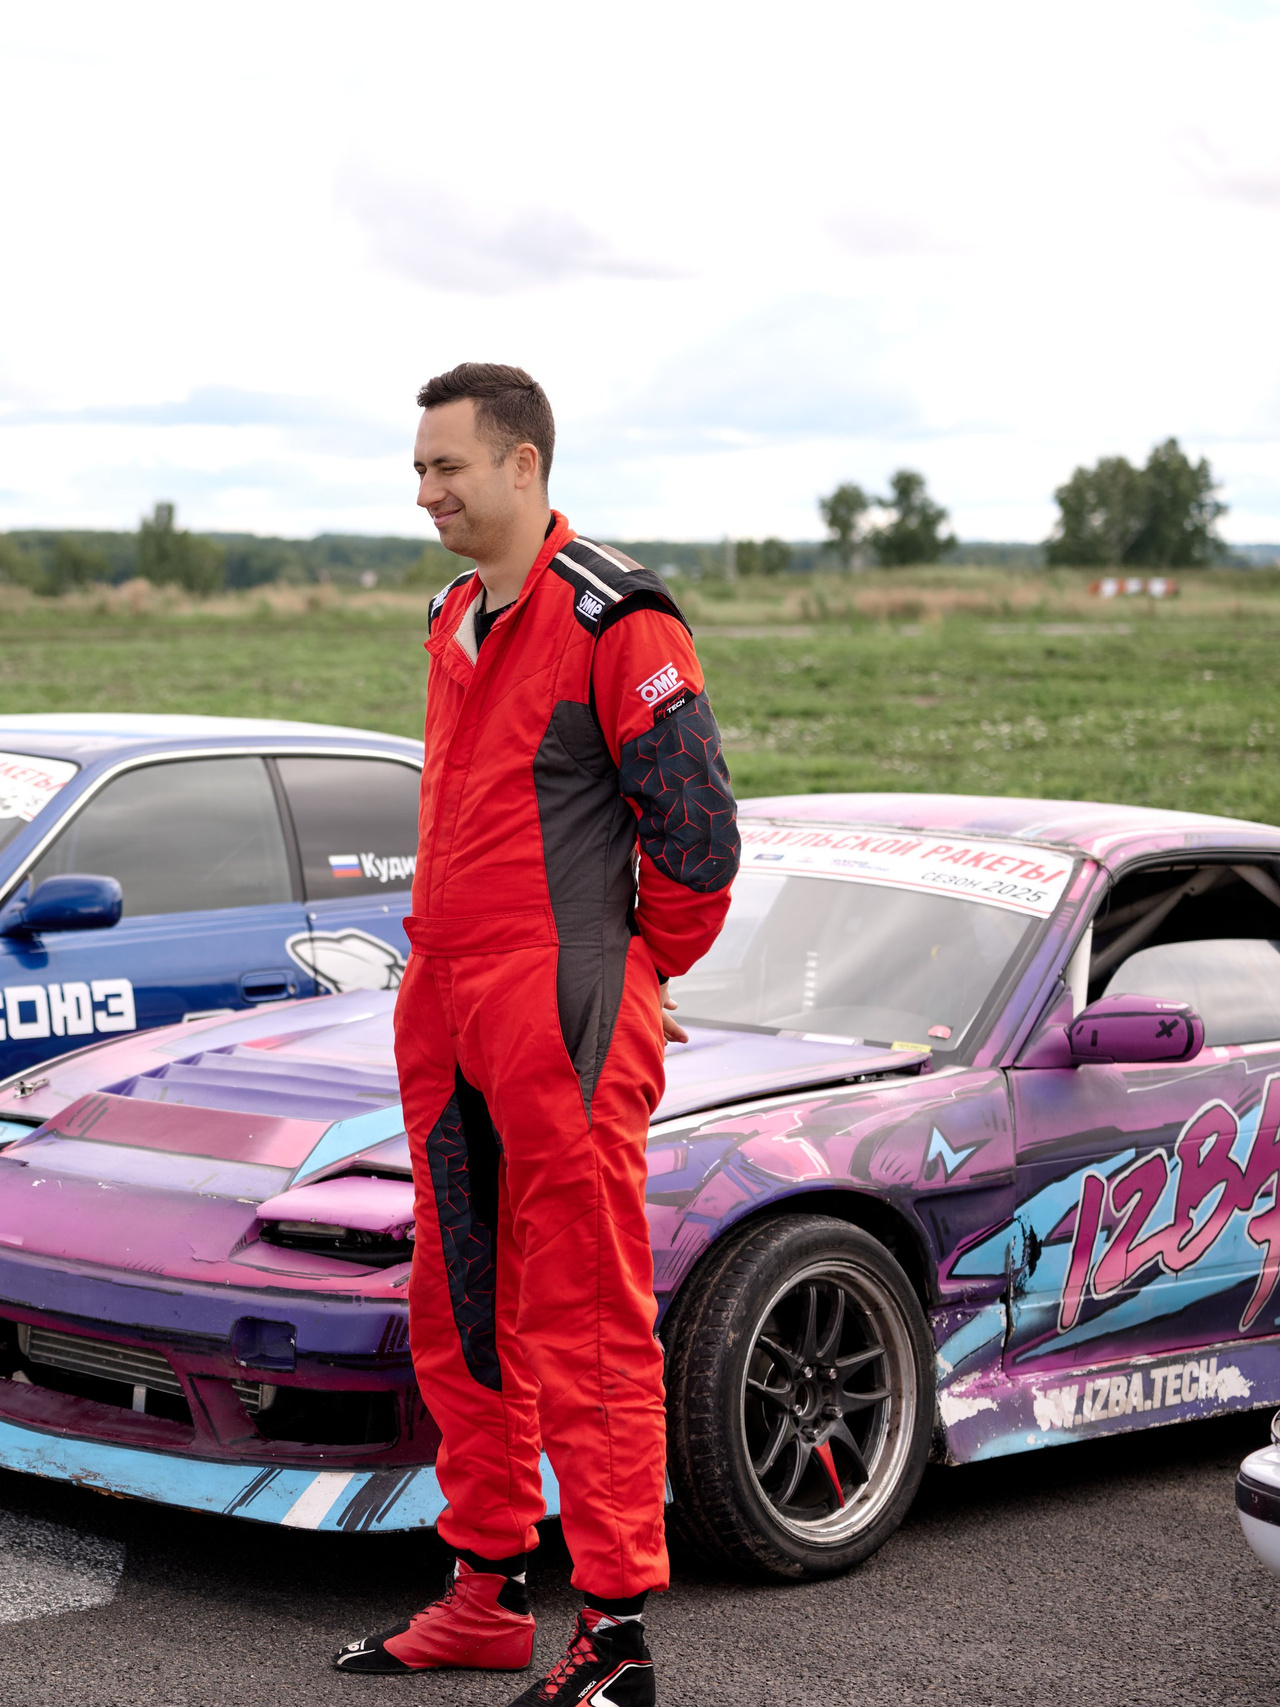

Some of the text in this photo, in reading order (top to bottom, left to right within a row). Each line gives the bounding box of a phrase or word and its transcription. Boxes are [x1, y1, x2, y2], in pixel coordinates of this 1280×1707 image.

[579, 594, 603, 617] OMP
[640, 667, 679, 702] OMP
[666, 698, 686, 713] TECH
[740, 829, 925, 857] НАУЛЬСКОЙ
[921, 844, 1068, 885] РАКЕТЫ
[922, 871, 1049, 903] СЕЗОН 2025
